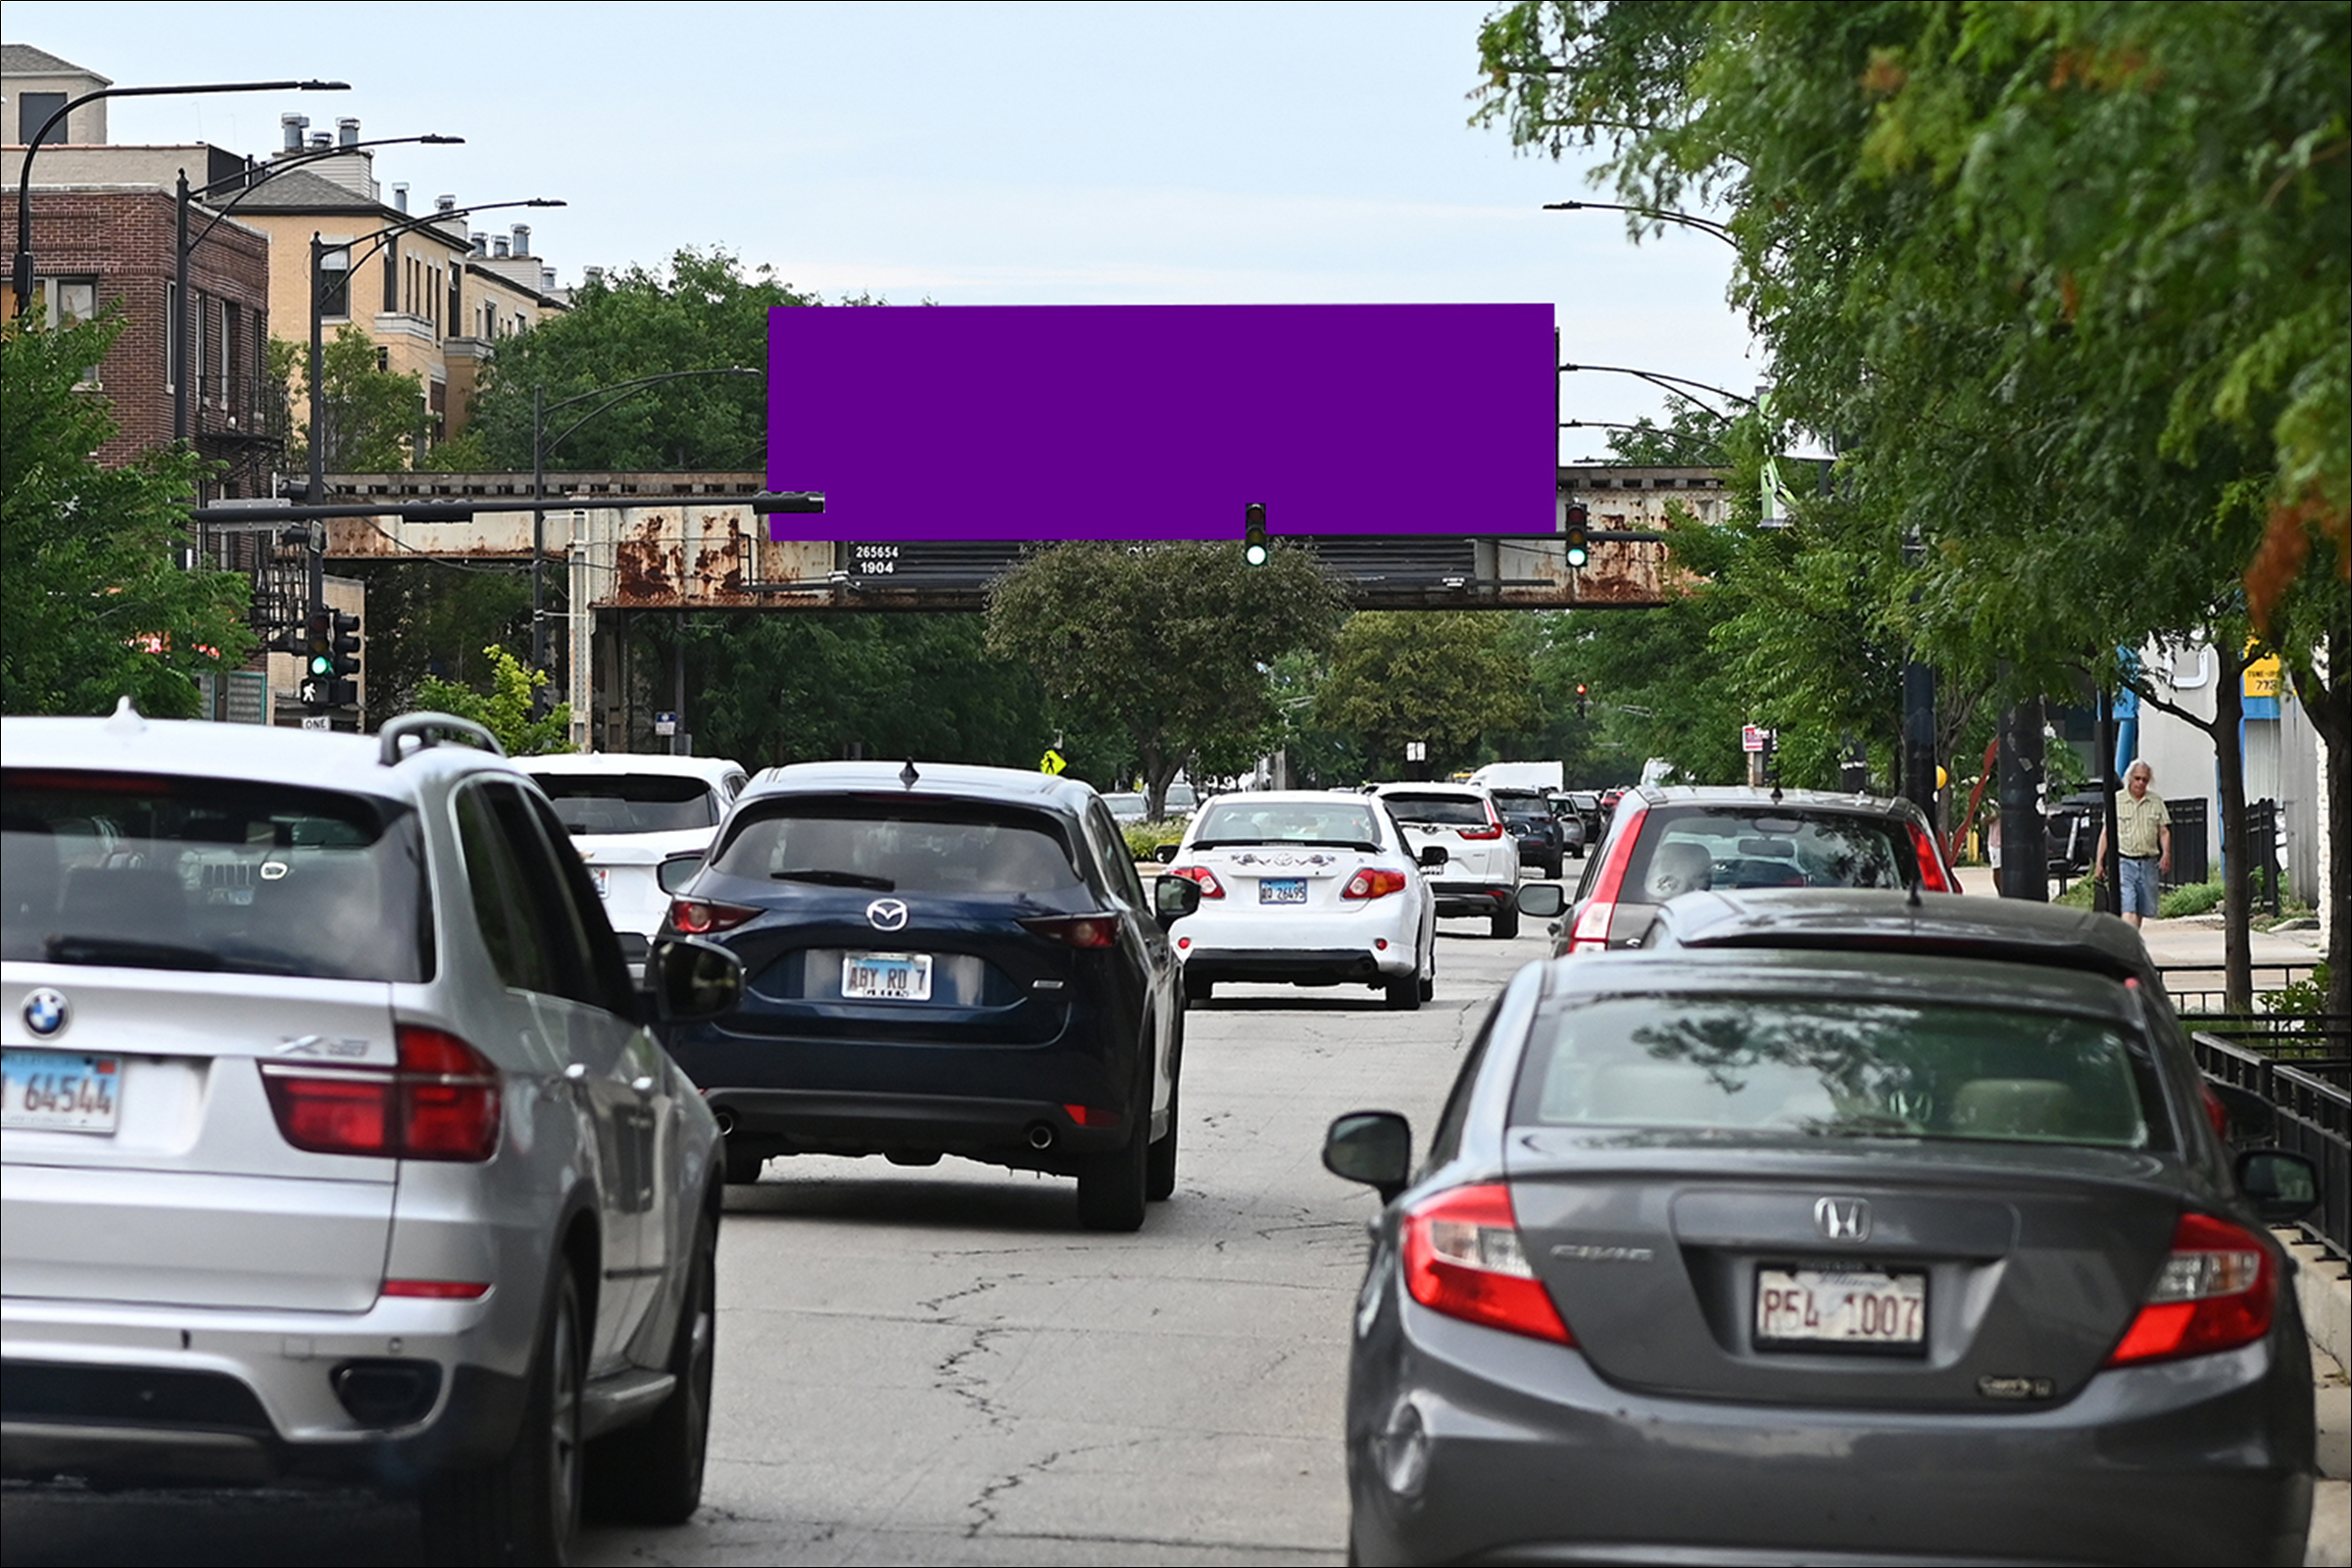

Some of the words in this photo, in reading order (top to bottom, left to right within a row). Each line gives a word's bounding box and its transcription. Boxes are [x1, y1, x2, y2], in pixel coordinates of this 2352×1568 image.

[856, 546, 899, 559] 265654
[860, 562, 894, 574] 1904
[305, 718, 326, 730] ONE
[849, 966, 879, 991] ABY
[887, 967, 907, 990] RD
[916, 968, 927, 992] 7
[24, 1072, 112, 1115] 64544
[1843, 1293, 1920, 1337] 1007
